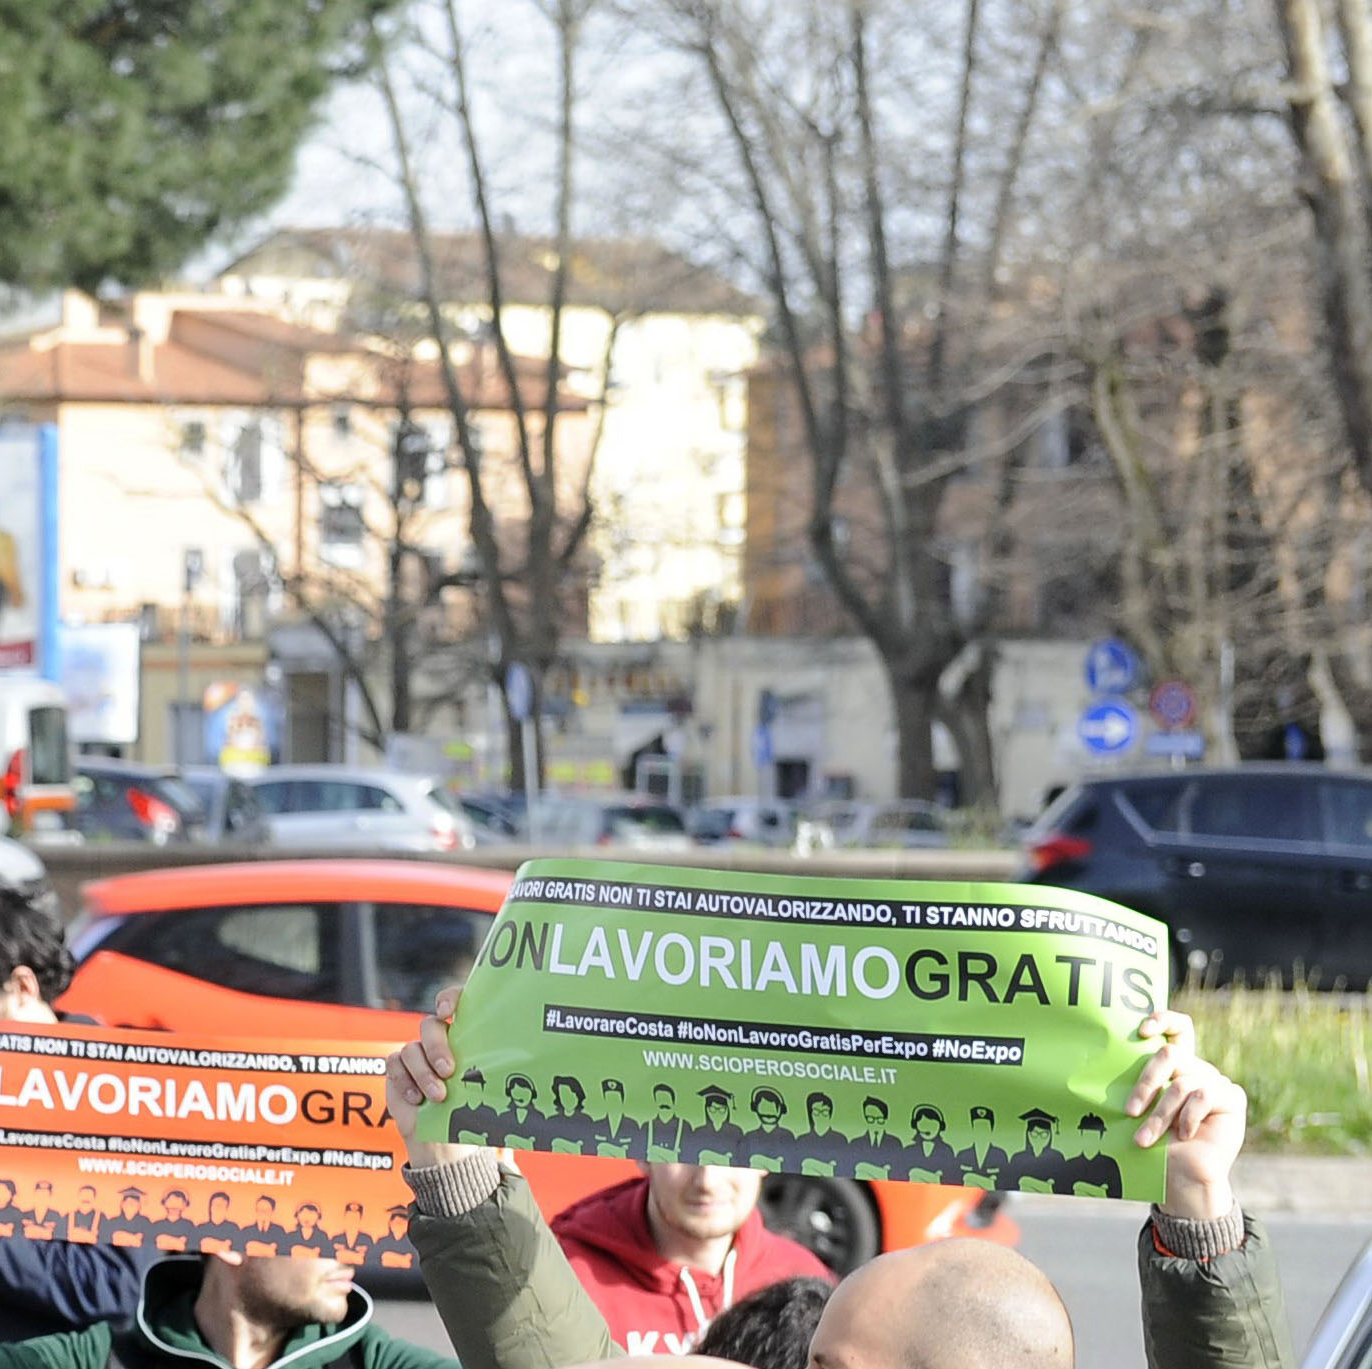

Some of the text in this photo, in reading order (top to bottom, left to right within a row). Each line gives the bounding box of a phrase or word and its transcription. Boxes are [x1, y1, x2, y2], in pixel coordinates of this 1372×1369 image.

[545, 882, 595, 901] GRATIS
[599, 885, 632, 905] NON
[637, 887, 651, 906] TI
[655, 889, 691, 910] STAI
[695, 893, 897, 926] AUTOVALORIZZANDO,
[902, 905, 920, 924] TI
[925, 906, 1015, 928] STANNO
[1020, 909, 1157, 955] SFRUTTANDO
[546, 1009, 1022, 1064] #LavorareCosta #IoNonLavoroGratisPerExpo #NoExpo
[34, 1037, 68, 1056] NON
[71, 1039, 86, 1057] TI
[87, 1042, 123, 1060] STAI
[124, 1045, 297, 1073] AUTOVALORIZZANDO,
[300, 1056, 316, 1073] TI
[318, 1057, 386, 1075] STANNO
[643, 1051, 897, 1085] WWW.SCIOPEROSOCIALE.IT
[79, 1157, 294, 1187] WWW.SCIOPEROSOCIALE.IT
[323, 1150, 393, 1171] #NoExpo
